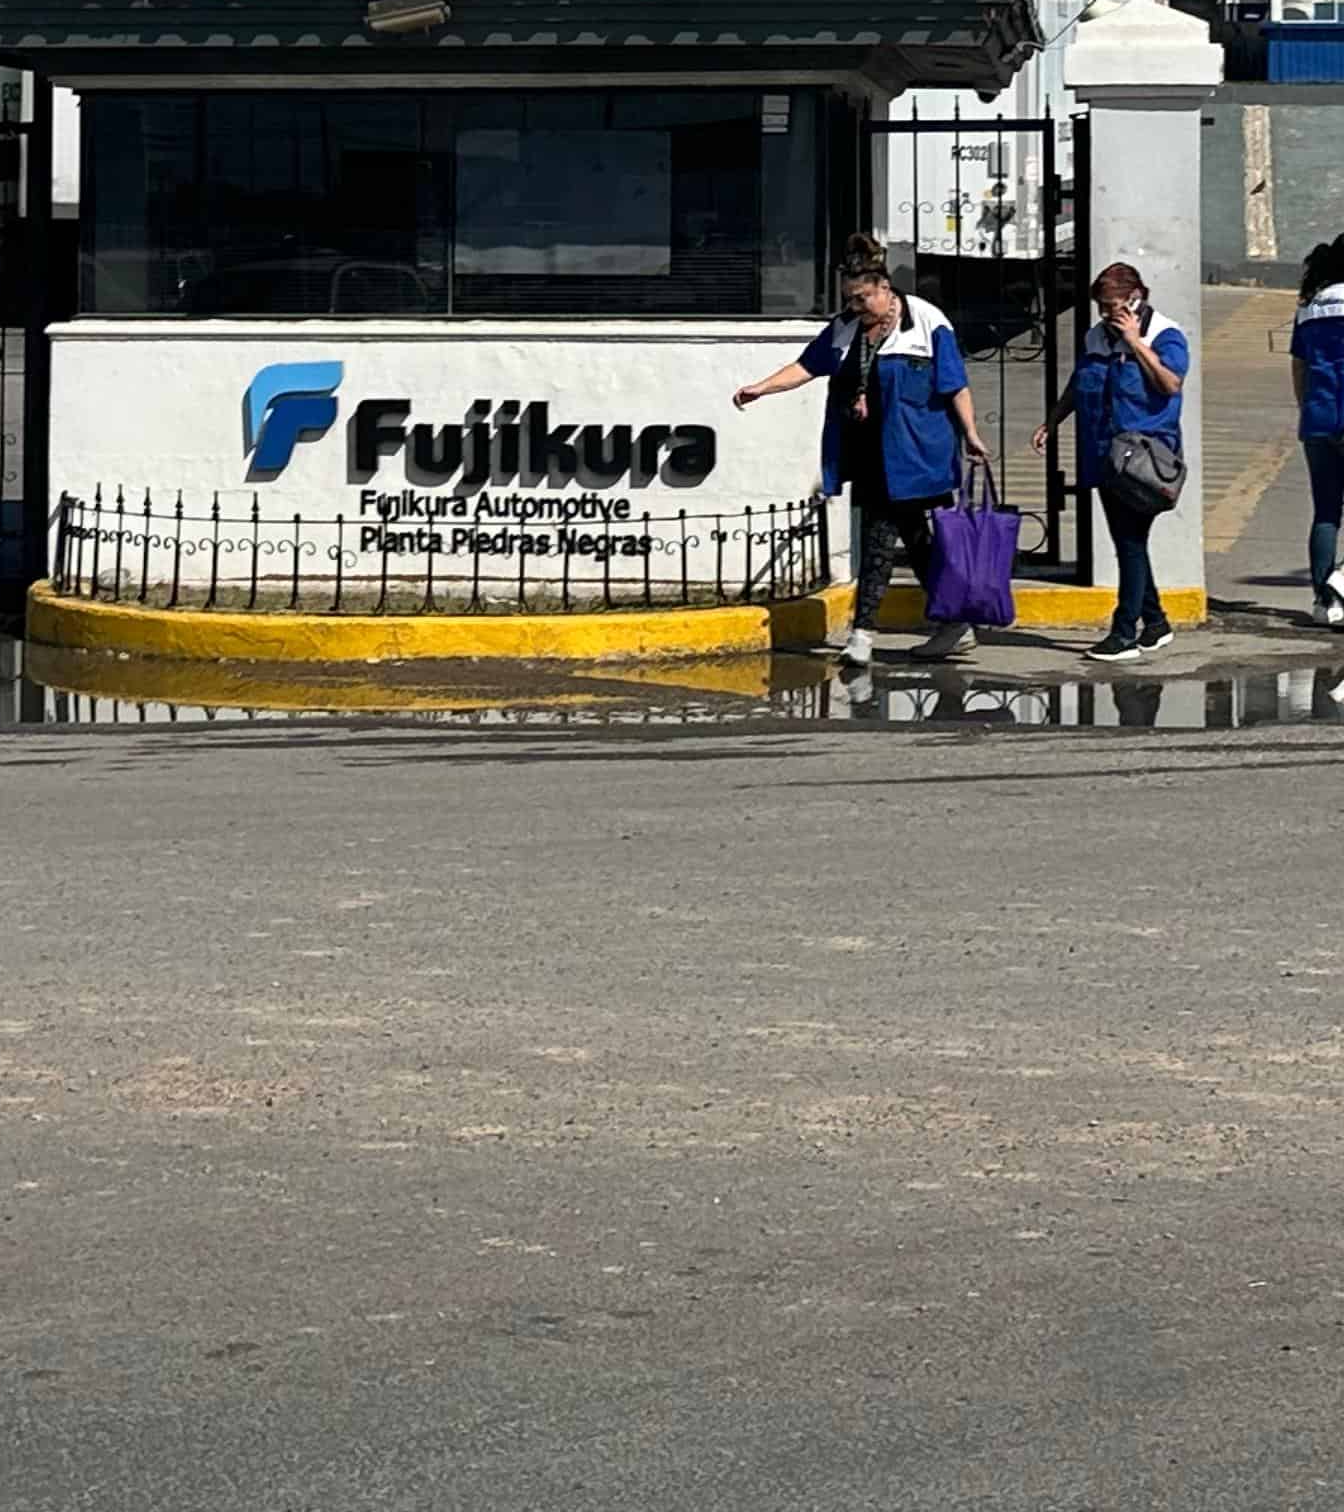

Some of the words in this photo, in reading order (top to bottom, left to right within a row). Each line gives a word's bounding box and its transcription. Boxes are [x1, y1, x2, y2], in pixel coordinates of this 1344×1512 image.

[350, 397, 717, 488] Fujikura
[359, 488, 468, 522] Fujikura
[472, 491, 632, 522] Automotive
[359, 524, 444, 554] Planta
[451, 525, 551, 556] Piedras
[556, 528, 654, 563] Negras
